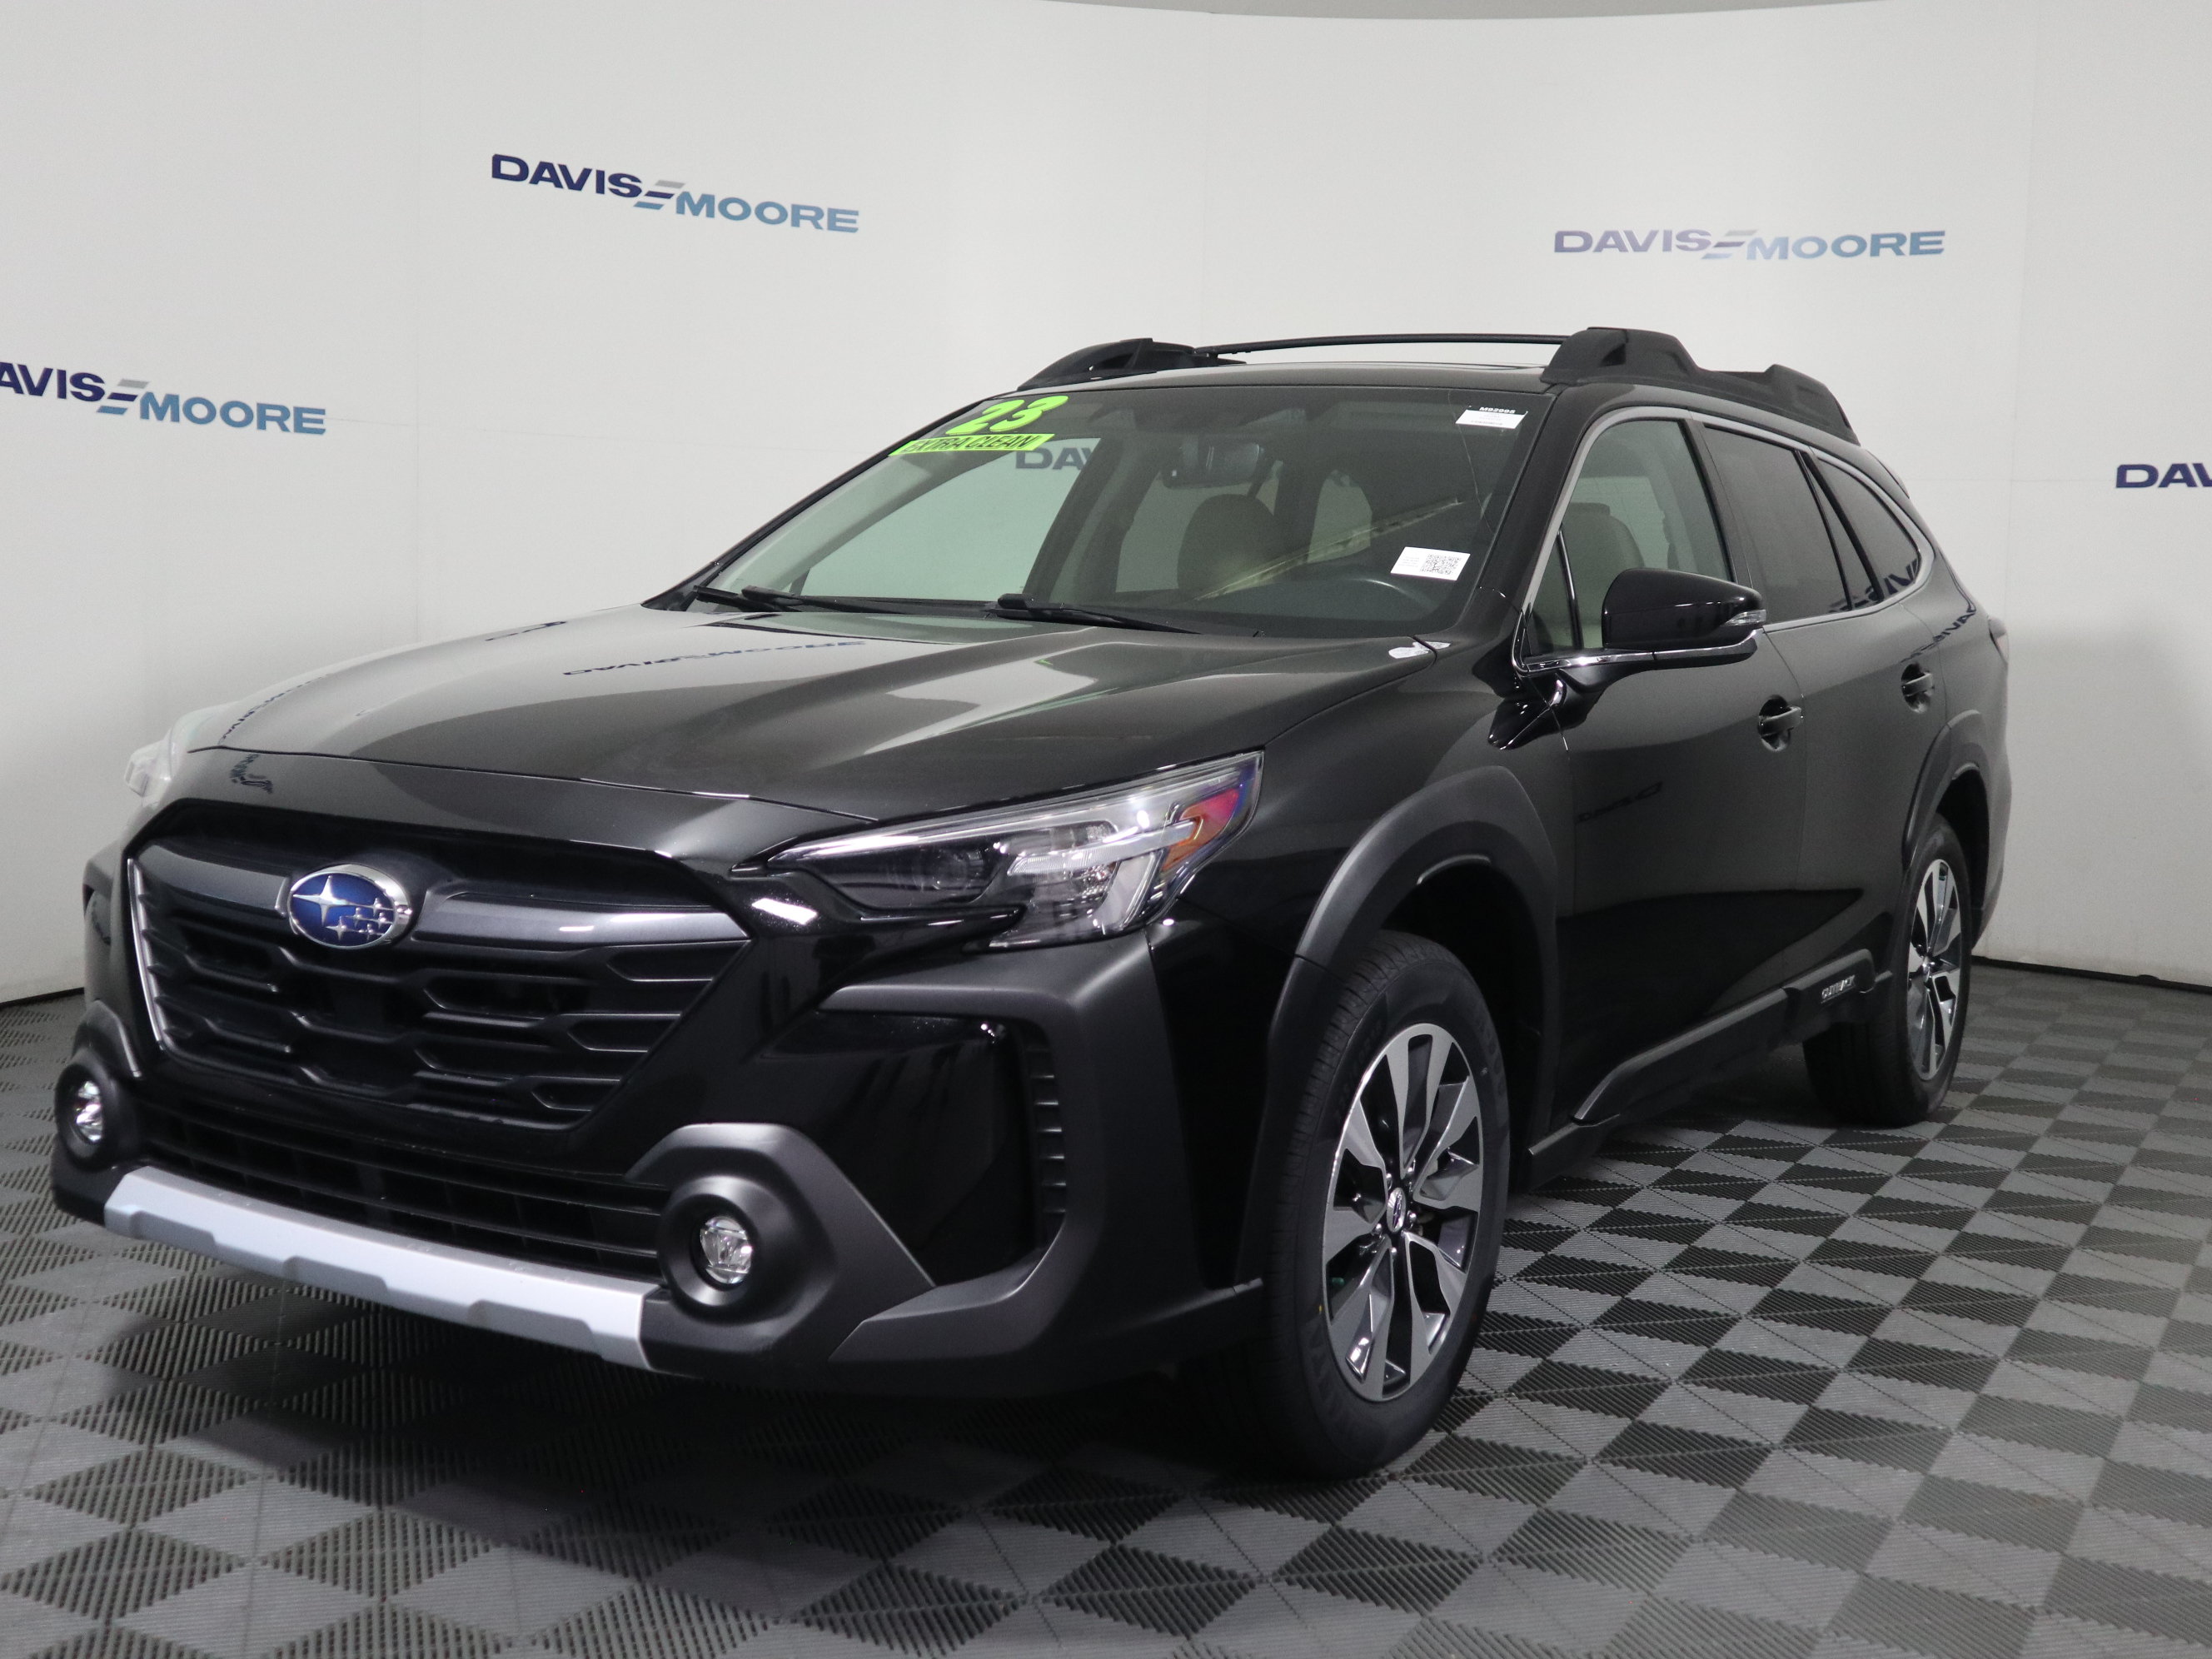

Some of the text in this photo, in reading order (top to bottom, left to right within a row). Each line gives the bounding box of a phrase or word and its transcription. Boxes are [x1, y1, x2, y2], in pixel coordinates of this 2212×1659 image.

[491, 152, 859, 234] DAVIS MOORE
[1554, 228, 1946, 260] DAVIS MOORE
[139, 391, 327, 436] MOORE
[944, 395, 1069, 435] 23
[899, 435, 1041, 453] EXTRA CLEAN
